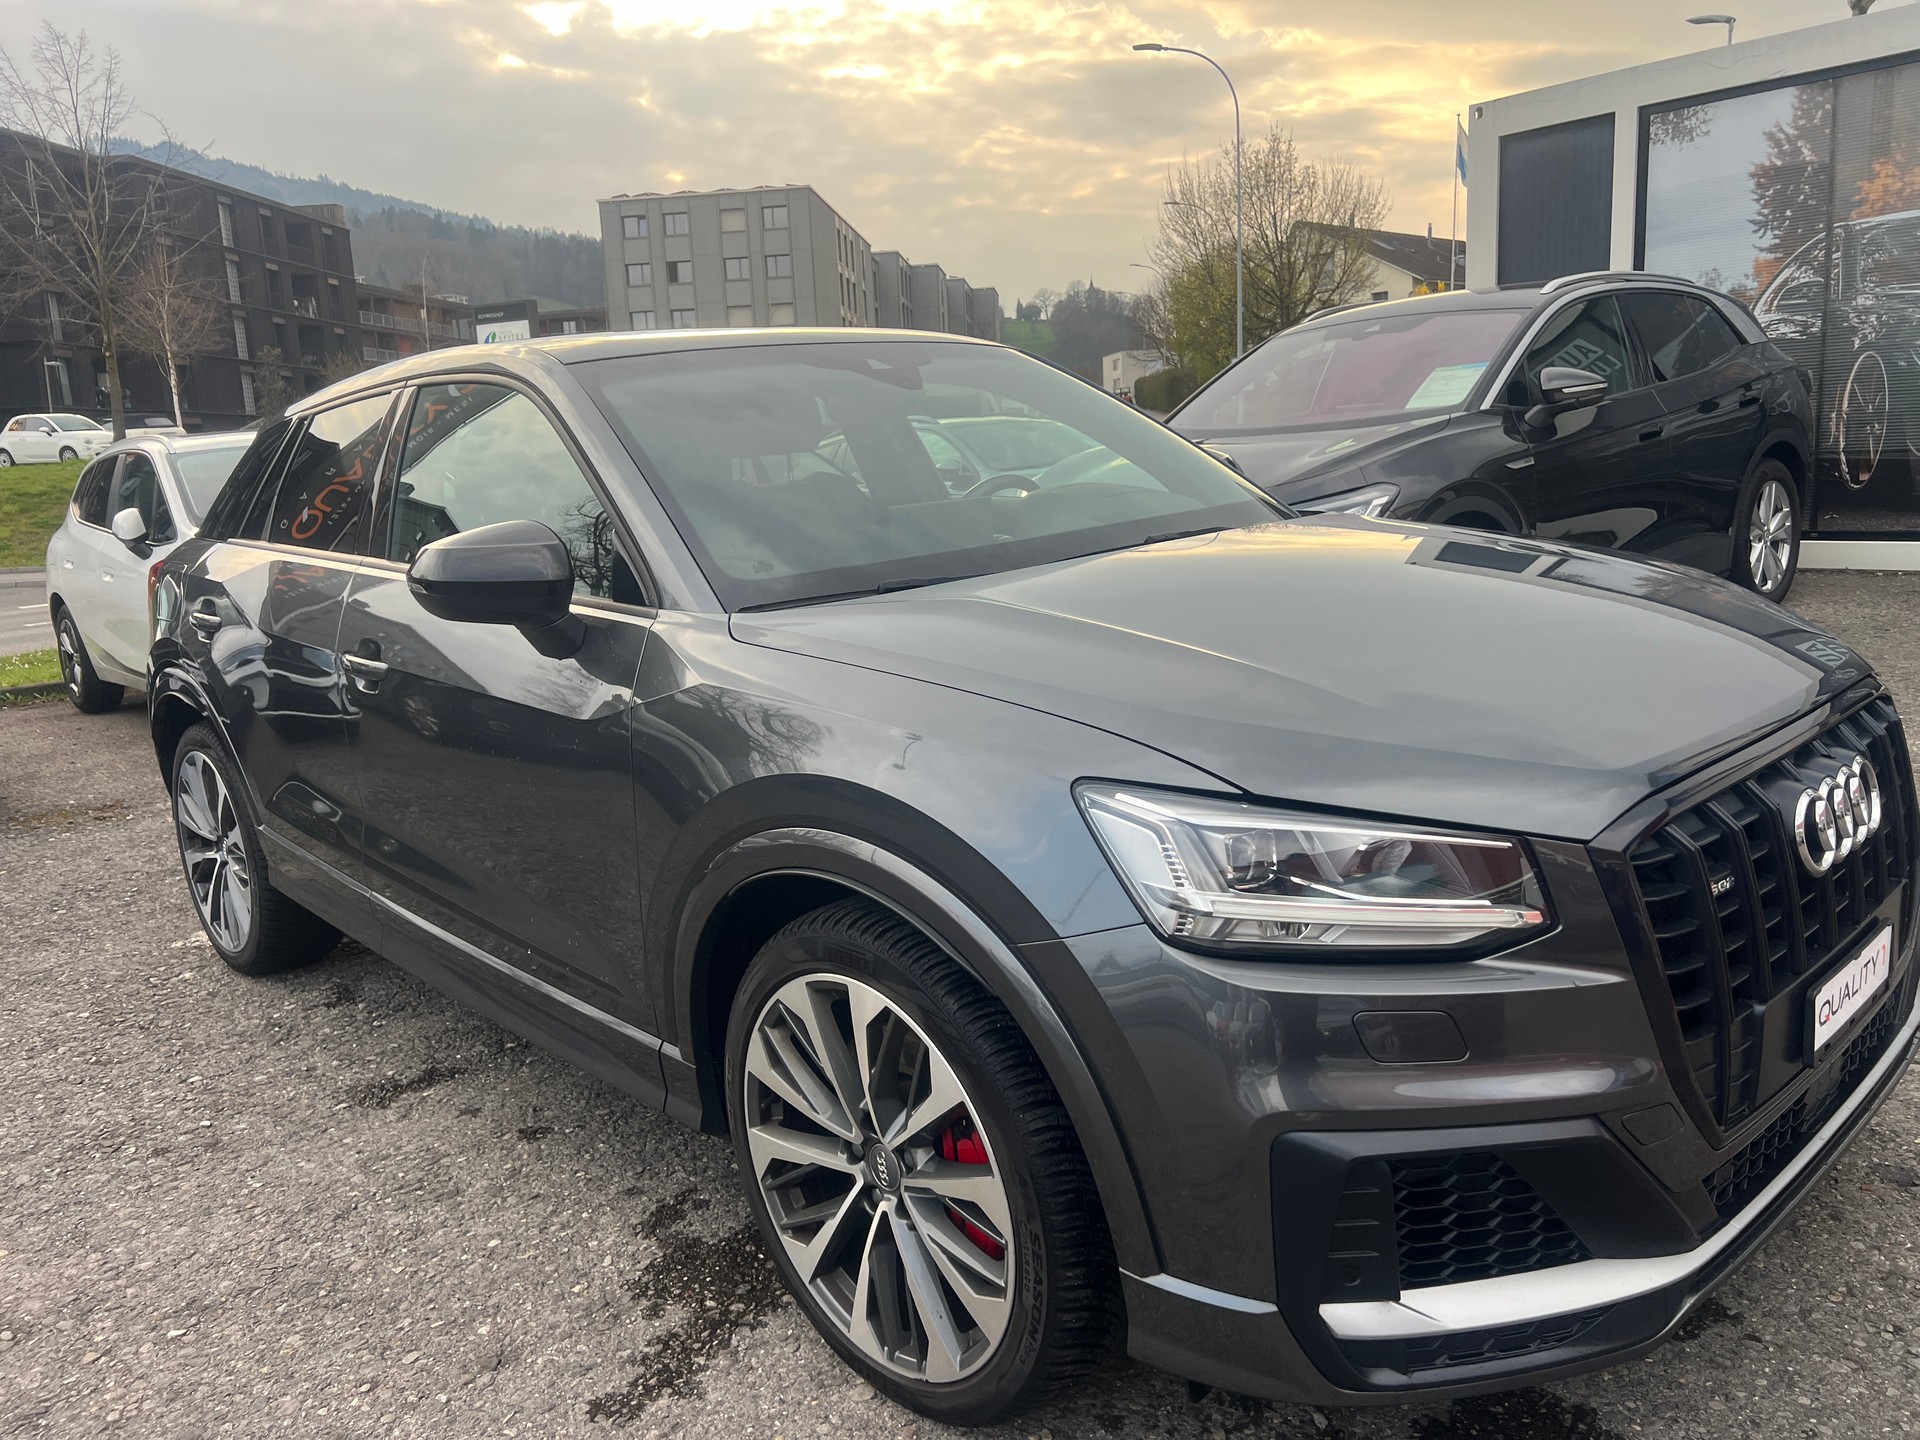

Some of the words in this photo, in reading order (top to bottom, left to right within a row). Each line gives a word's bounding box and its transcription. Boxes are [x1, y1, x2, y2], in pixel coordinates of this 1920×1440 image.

[1819, 949, 1881, 1027] QUALITY
[1881, 944, 1886, 966] 1
[1028, 1228, 1044, 1343] SEASON
